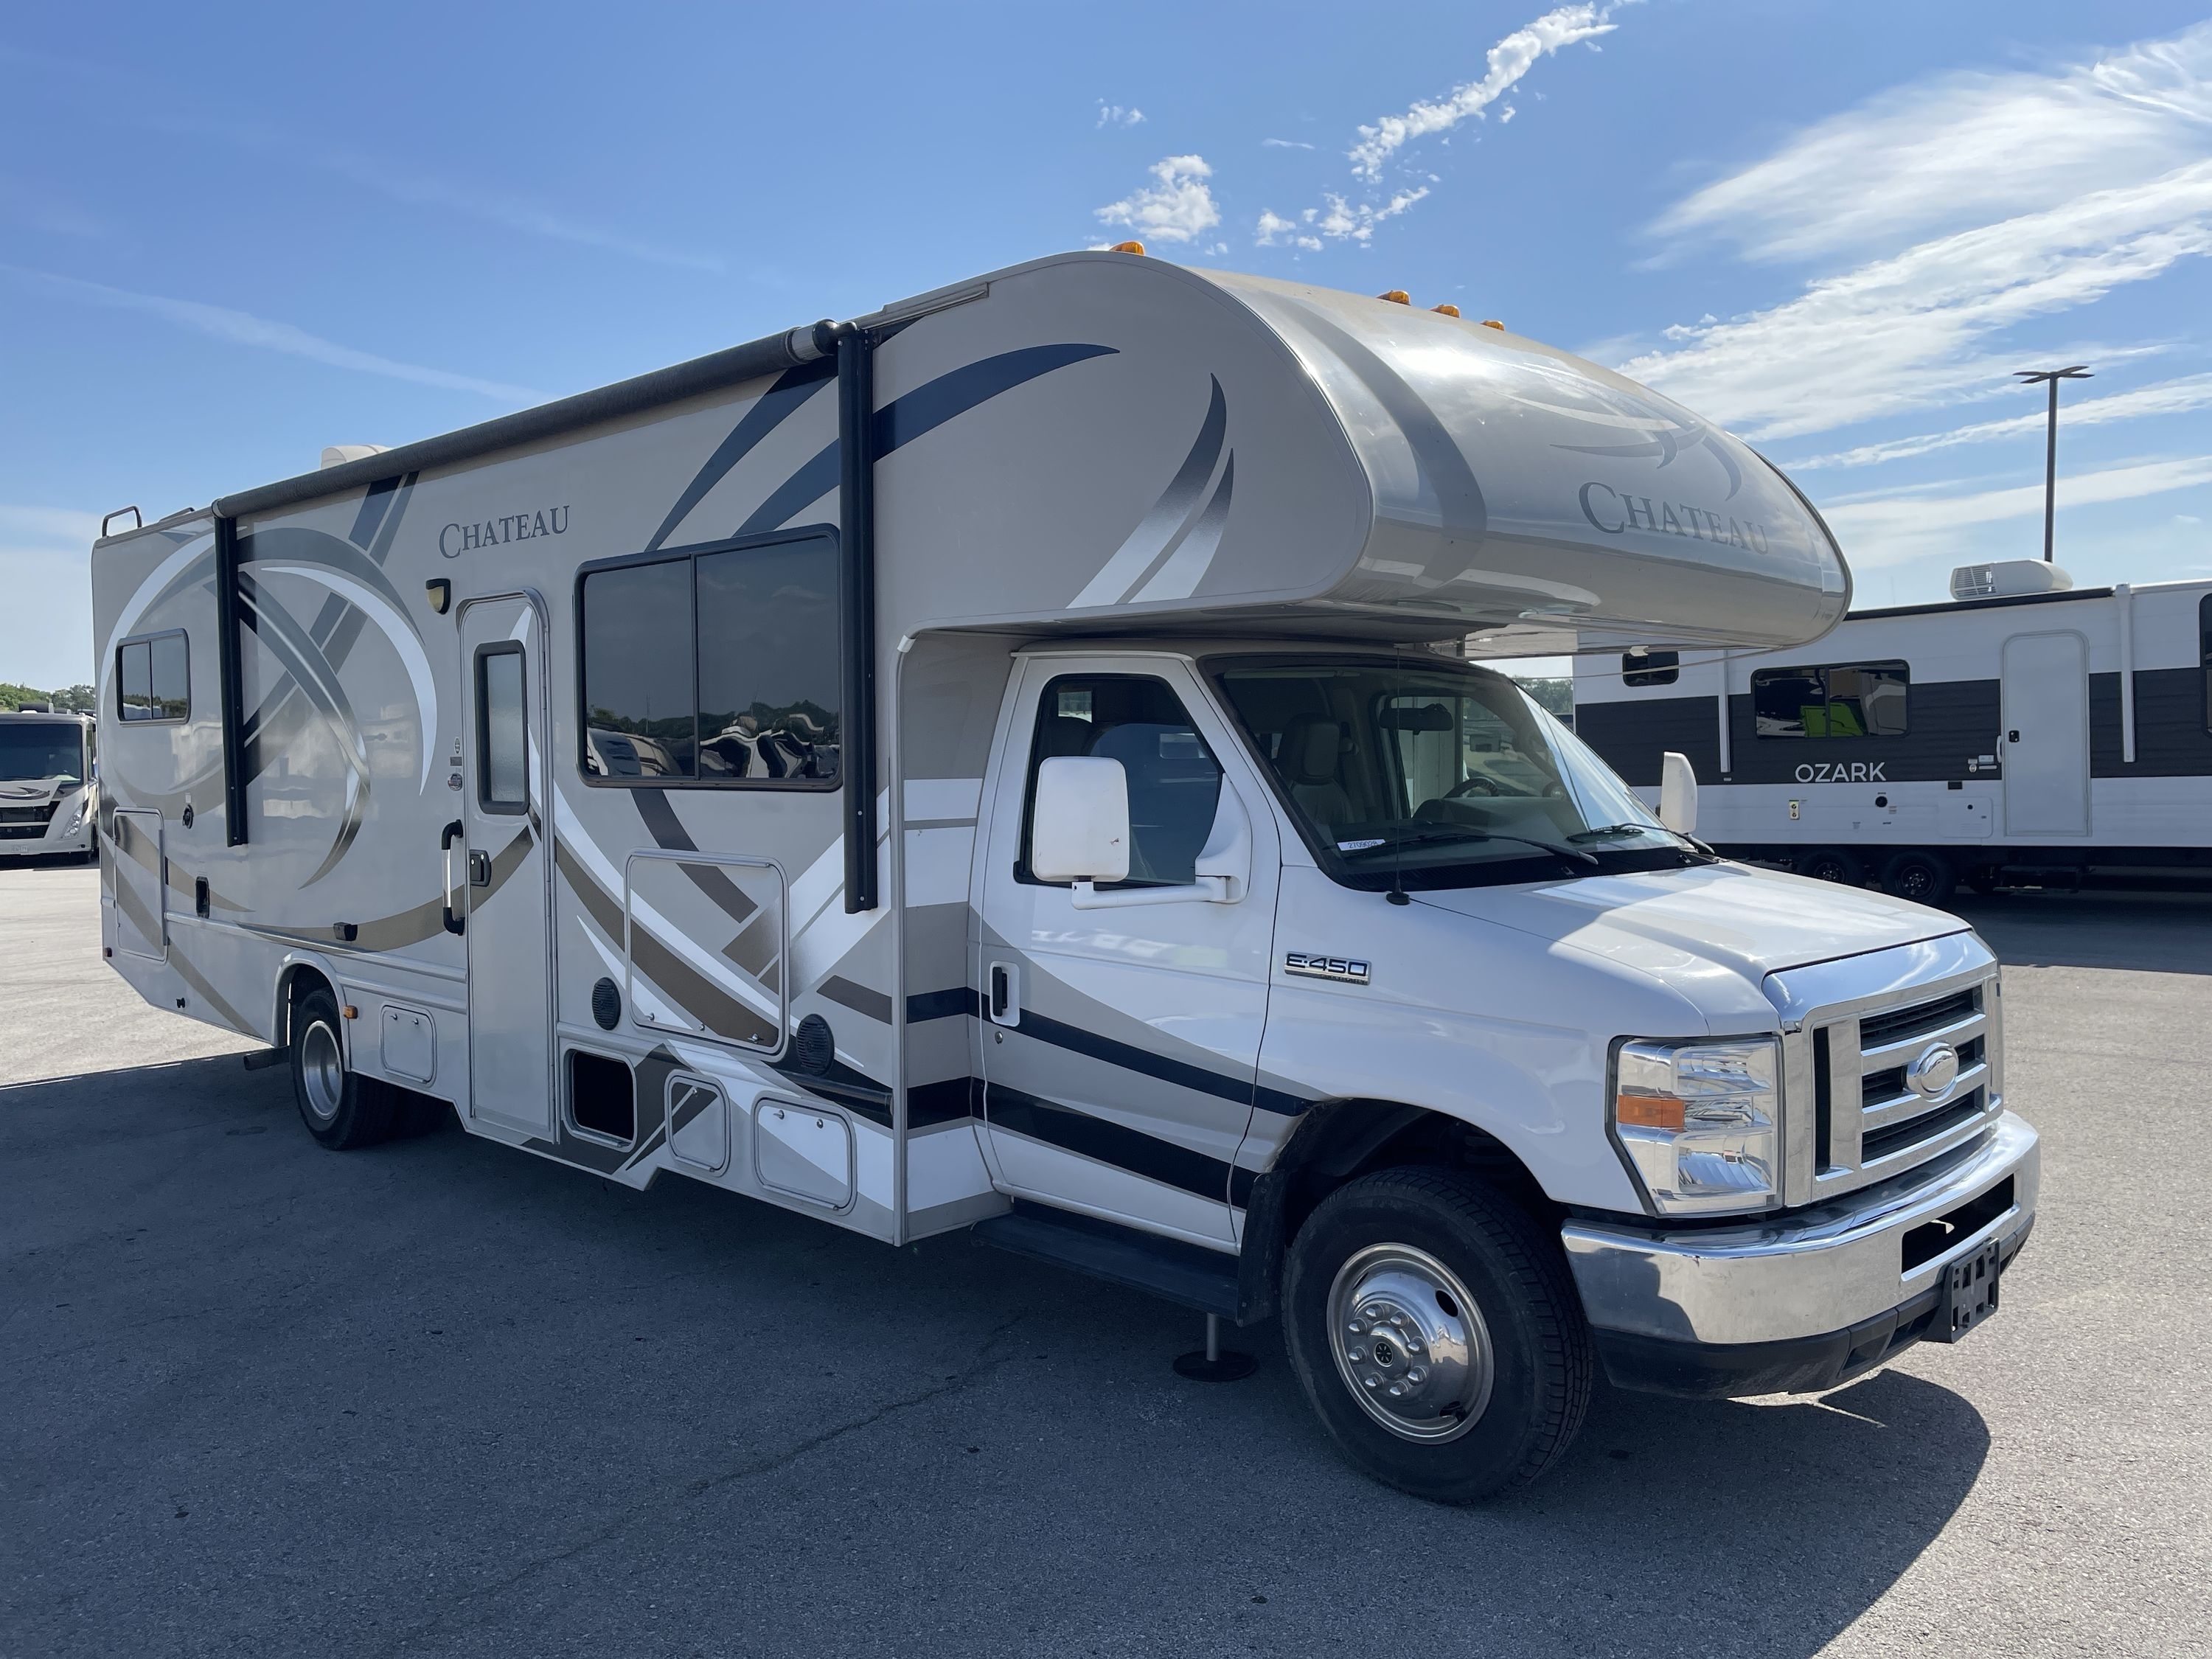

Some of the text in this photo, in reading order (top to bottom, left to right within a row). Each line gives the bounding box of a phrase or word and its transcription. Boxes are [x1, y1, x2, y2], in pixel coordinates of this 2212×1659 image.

[439, 505, 570, 559] CHATEAU
[1578, 481, 1769, 554] CHATEAU
[1795, 762, 1887, 783] OZARK
[1286, 953, 1368, 977] E-450
